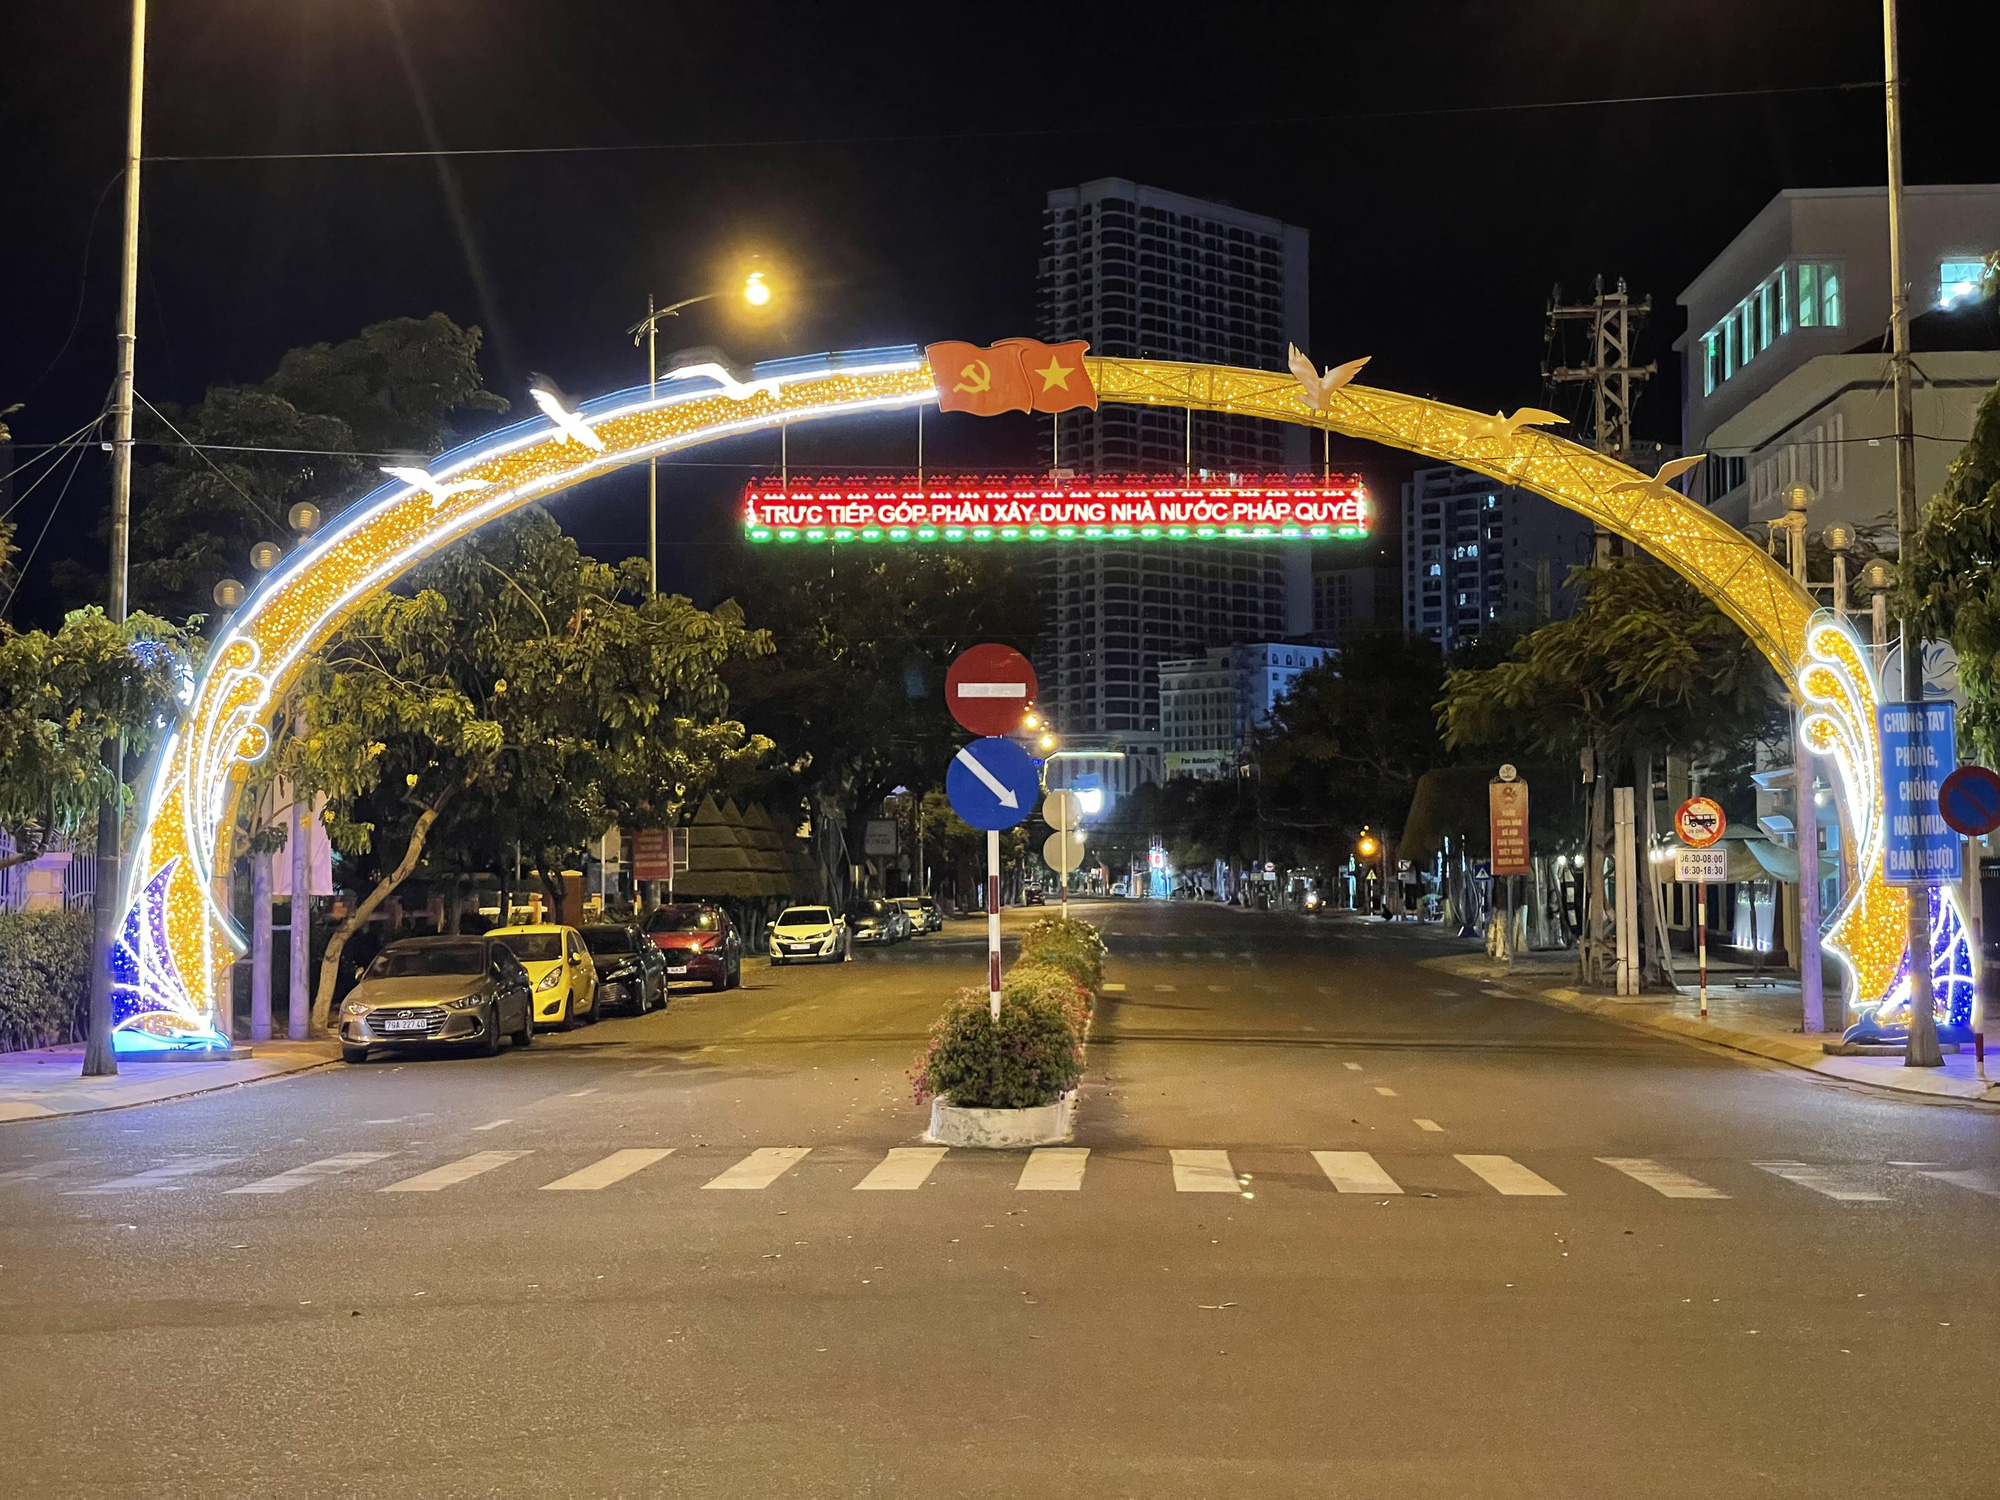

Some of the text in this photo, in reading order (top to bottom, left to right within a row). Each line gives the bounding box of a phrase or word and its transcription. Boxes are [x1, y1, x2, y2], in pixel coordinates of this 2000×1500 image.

[878, 502, 927, 523] GÓP
[993, 501, 1036, 522] XÂY
[1112, 500, 1156, 521] NHÀ
[1161, 500, 1228, 521] NƯỚC
[1233, 499, 1291, 520] PHÁP
[1883, 711, 1946, 733] CHUNG TAY
[1895, 744, 1939, 768] PHÒNG,
[1899, 774, 1939, 801] CHỐNG
[1894, 814, 1948, 840] NẠN MUA
[1680, 854, 1723, 863] 06:30-08:00
[1890, 844, 1954, 870] BÁN NGƯỜI
[1680, 865, 1723, 875] 16:30-18:30
